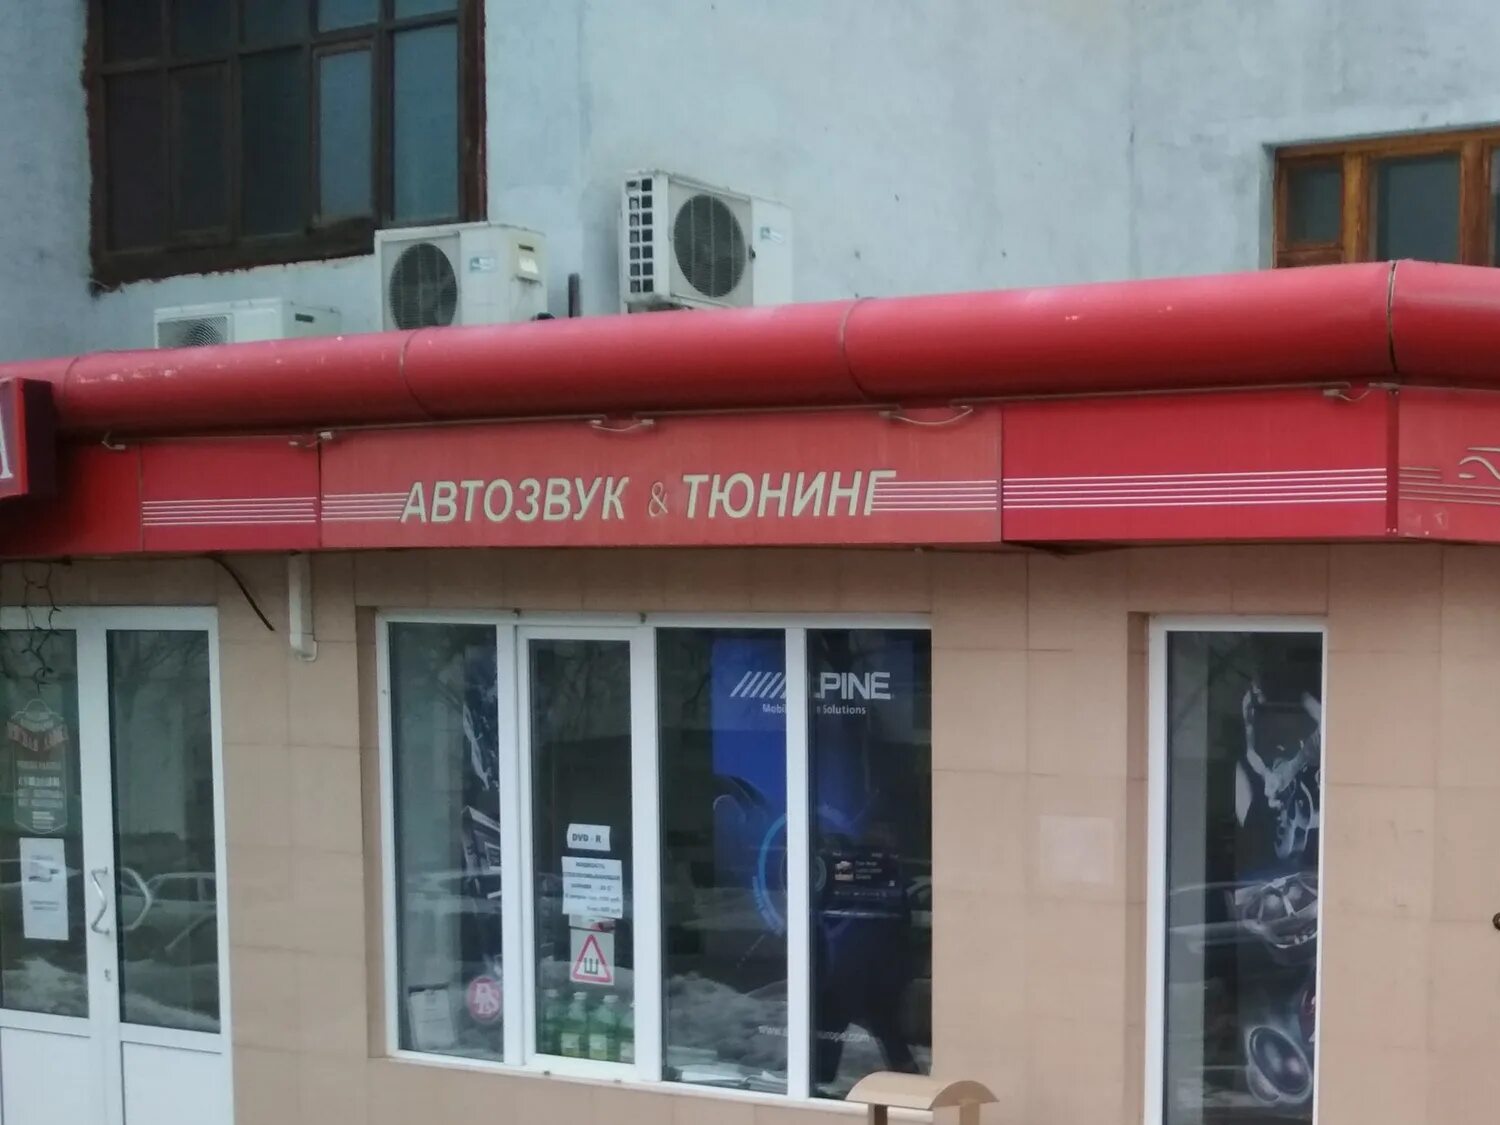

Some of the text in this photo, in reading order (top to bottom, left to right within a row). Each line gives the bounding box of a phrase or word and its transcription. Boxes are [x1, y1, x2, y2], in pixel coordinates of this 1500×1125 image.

[401, 469, 897, 525] АВТОЗВУК & ТЮНИНГ
[788, 671, 892, 700] PINE
[823, 704, 866, 715] Solutions
[572, 833, 589, 842] DVD
